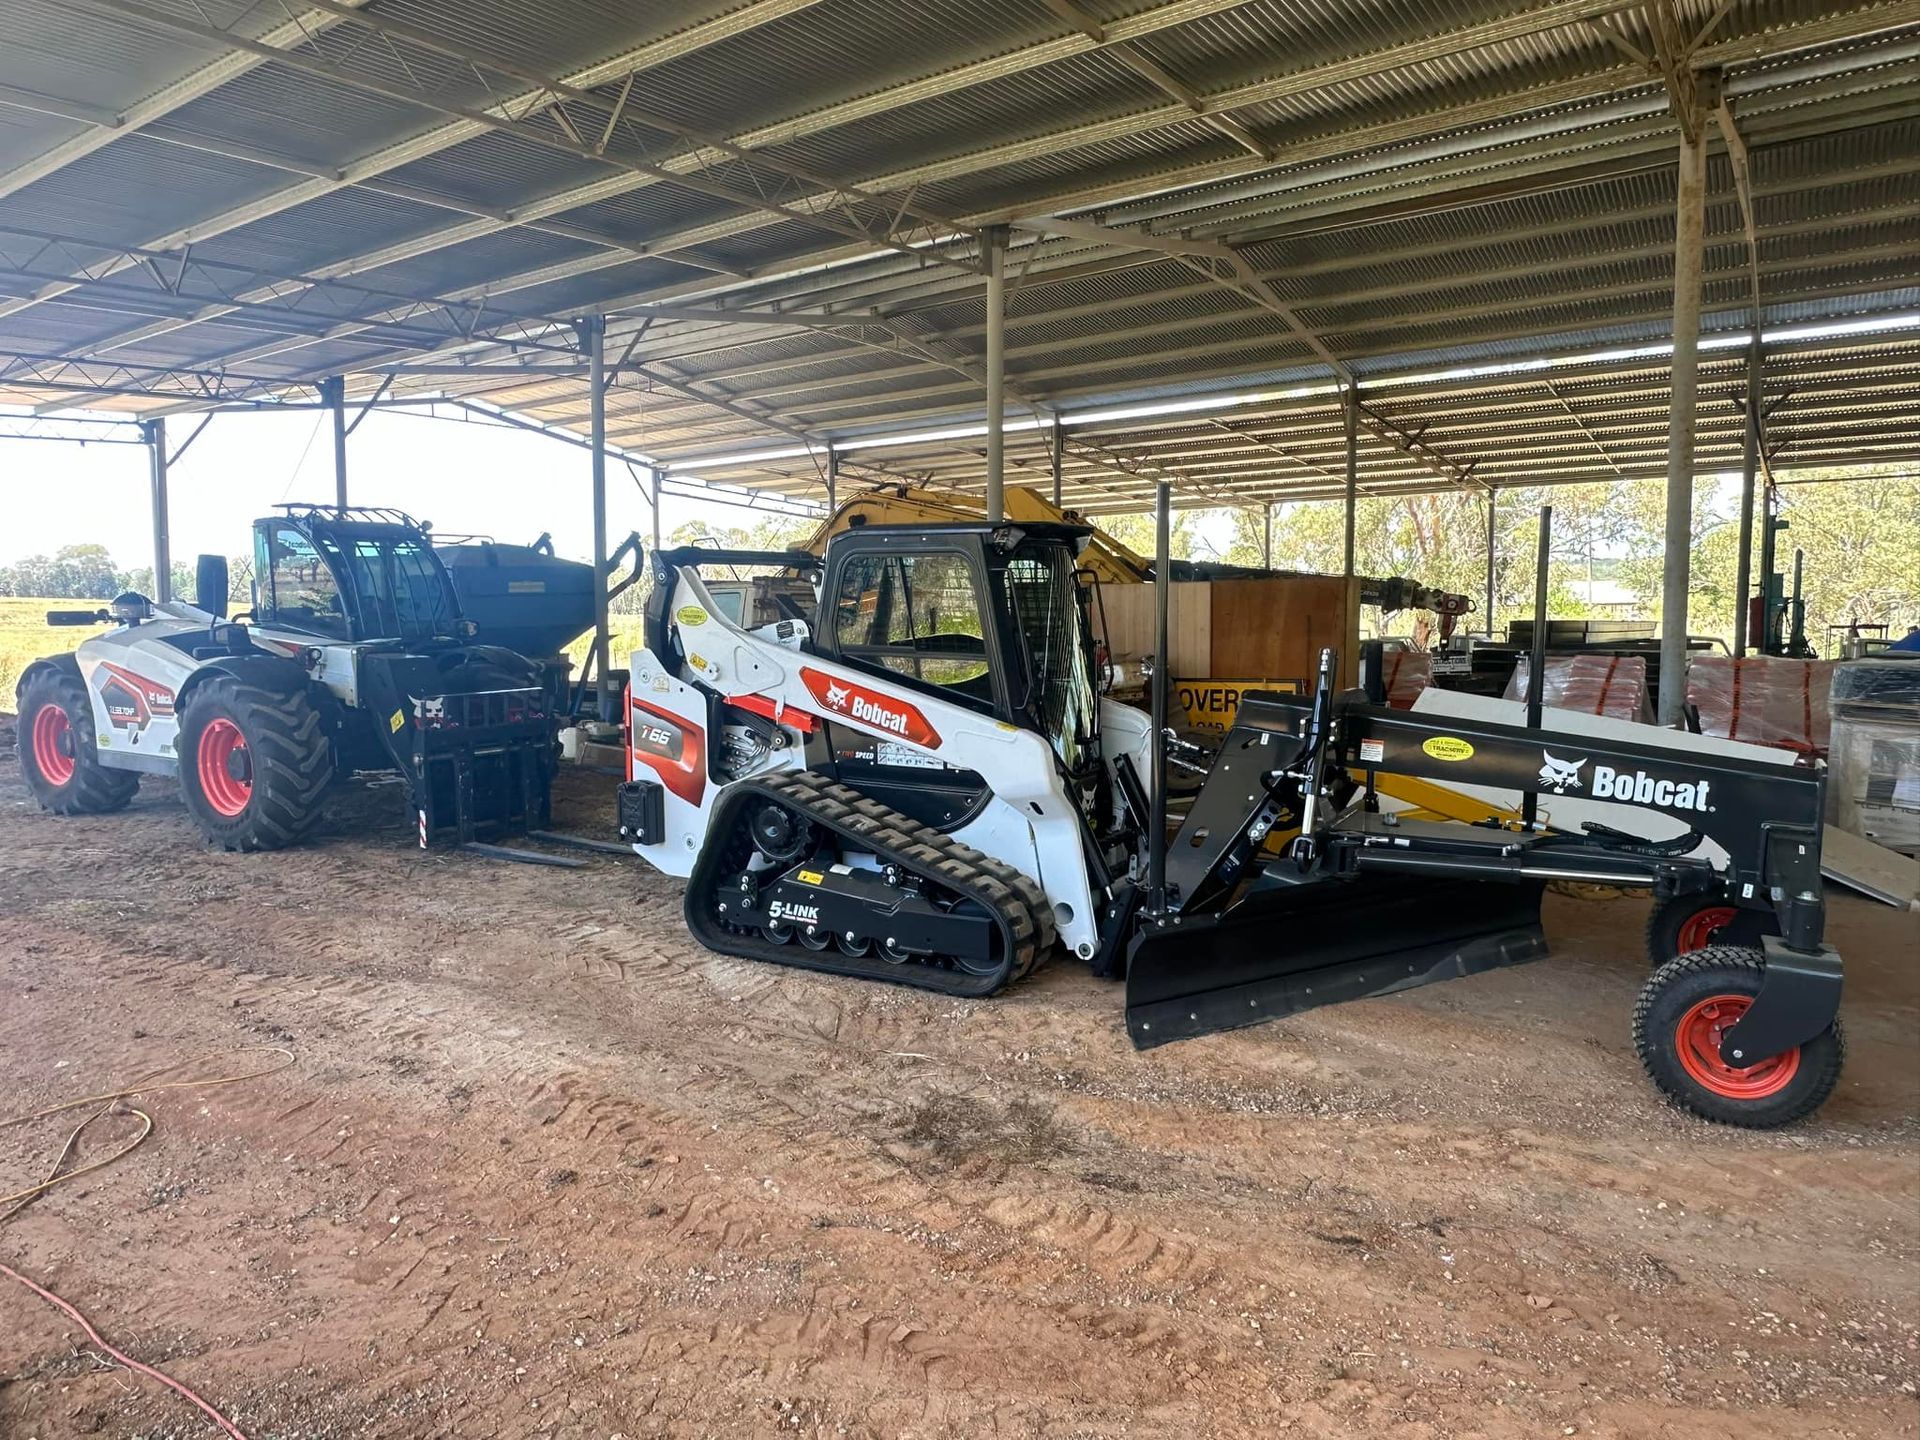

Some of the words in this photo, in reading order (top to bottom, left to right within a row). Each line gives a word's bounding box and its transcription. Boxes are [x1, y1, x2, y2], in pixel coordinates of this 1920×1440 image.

[852, 696, 909, 735] Bobcat
[641, 724, 671, 745] T66
[855, 751, 874, 759] SPEED
[1592, 766, 1709, 811] Bobcat
[769, 901, 820, 919] 5-LINK
